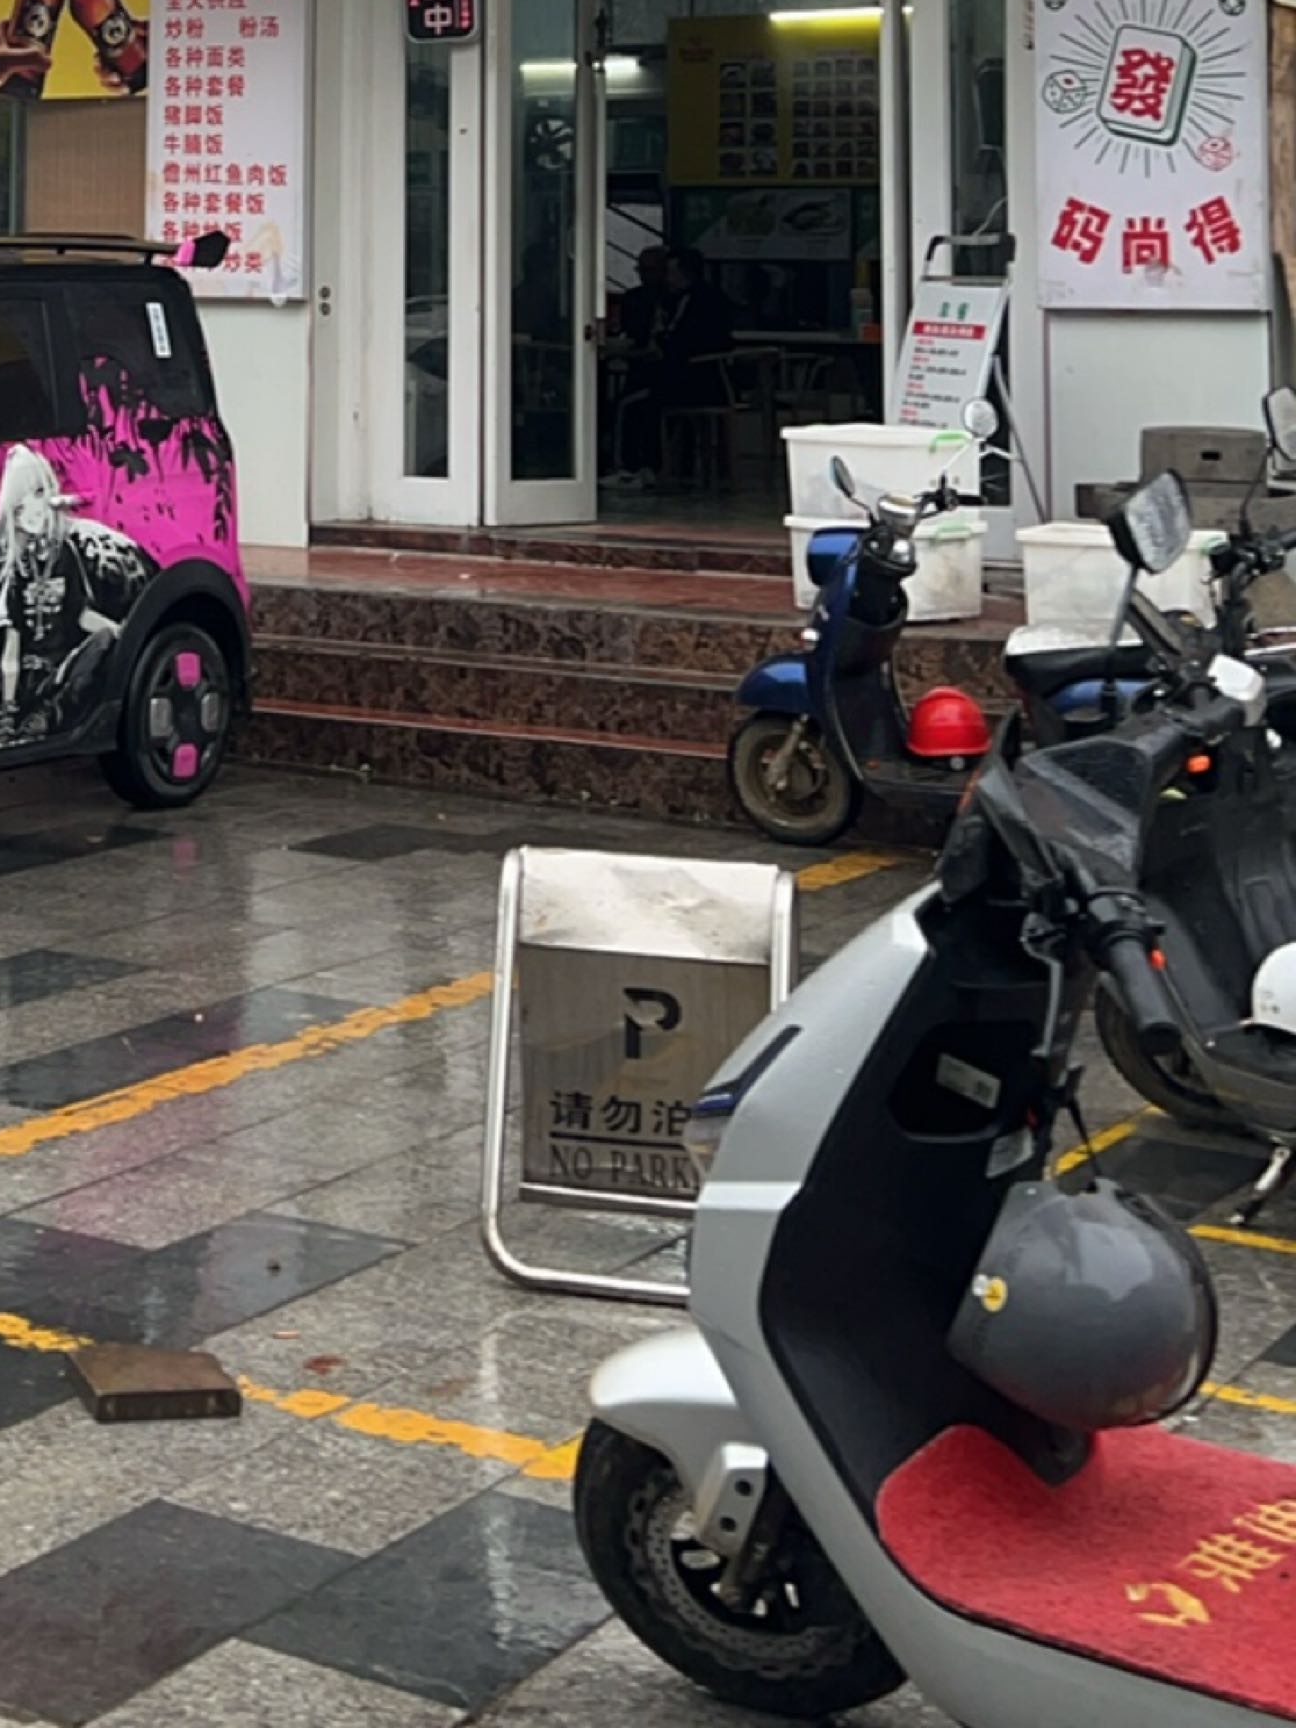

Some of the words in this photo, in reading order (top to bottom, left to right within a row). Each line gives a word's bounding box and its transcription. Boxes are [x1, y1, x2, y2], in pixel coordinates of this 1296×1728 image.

[165, 17, 204, 39] 炒粉
[239, 16, 280, 38] 粉汤
[164, 75, 246, 97] 各种套餐
[163, 192, 265, 214] 各种套餐饭
[1051, 195, 1243, 275] 码尚得
[621, 986, 683, 1060] P
[549, 1091, 693, 1137] 请勿泊
[549, 1143, 593, 1180] NO
